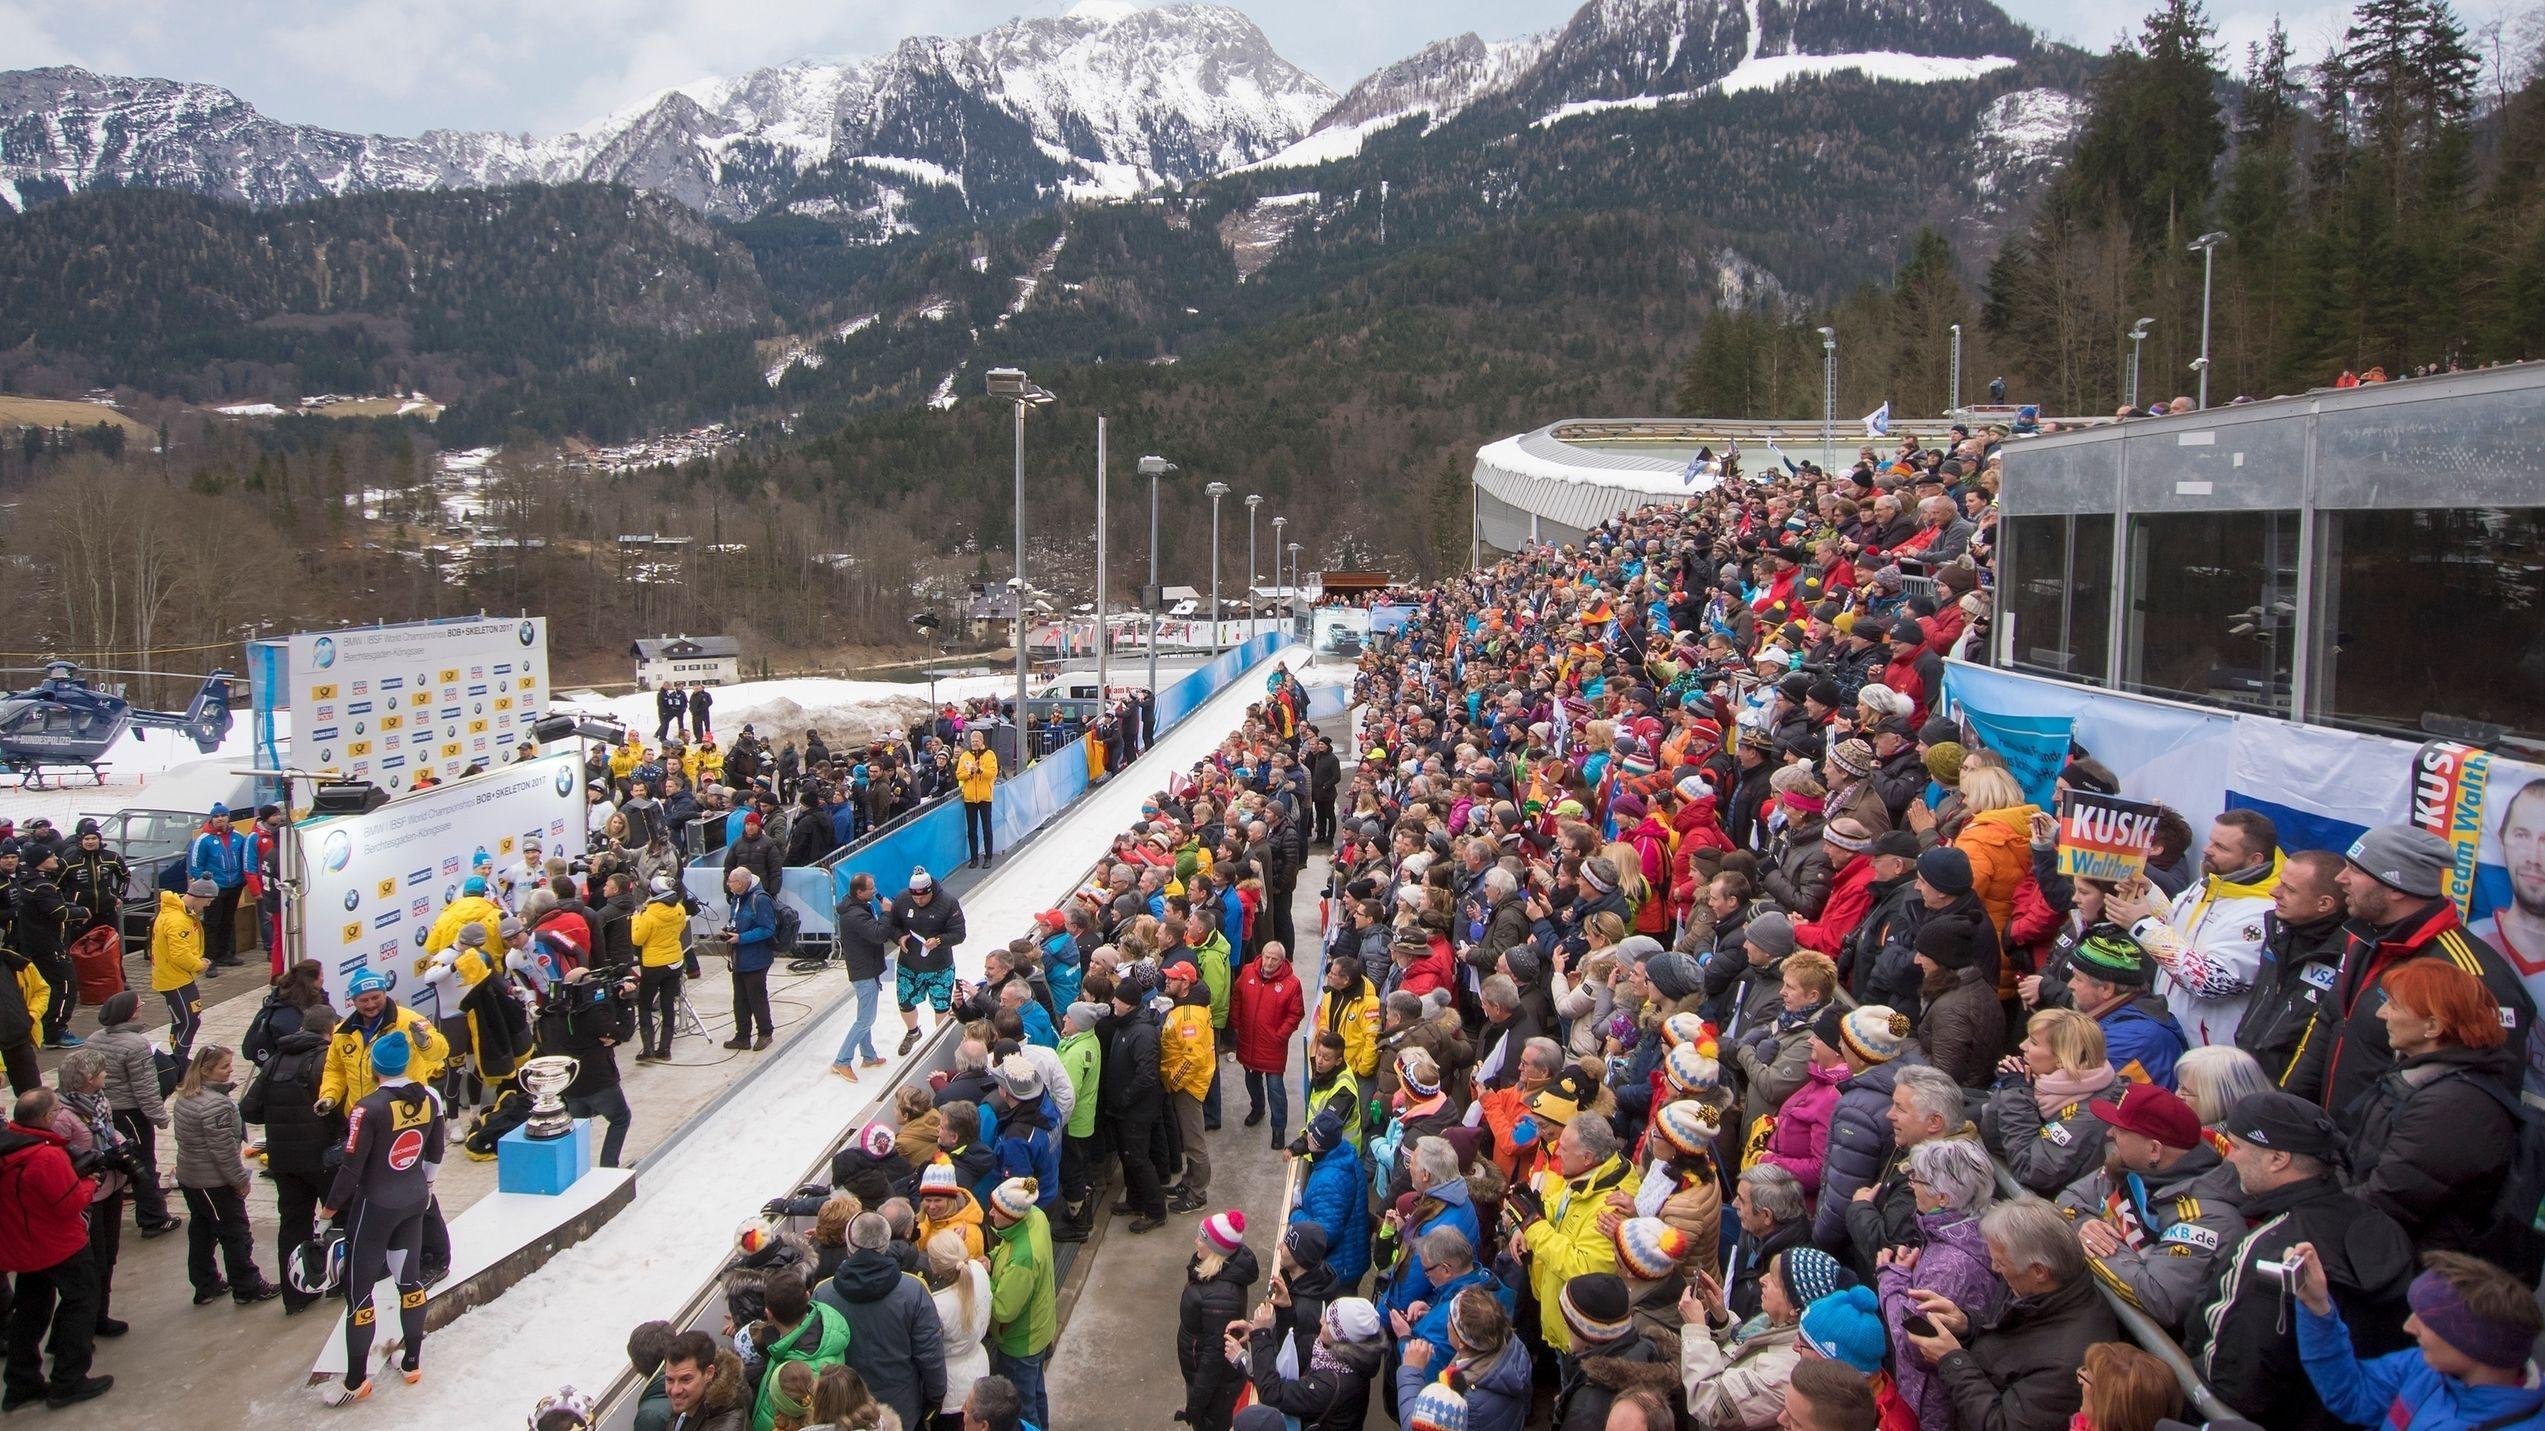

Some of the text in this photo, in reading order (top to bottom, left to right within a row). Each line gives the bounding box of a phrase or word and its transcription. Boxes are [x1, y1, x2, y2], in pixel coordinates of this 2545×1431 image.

[499, 623, 513, 633] 2017
[20, 735, 72, 746] BUNDESPOLIZEI
[495, 781, 531, 799] SKELETON
[531, 776, 547, 788] 2017
[2071, 803, 2160, 848] KUSKE
[2071, 849, 2140, 879] Walther
